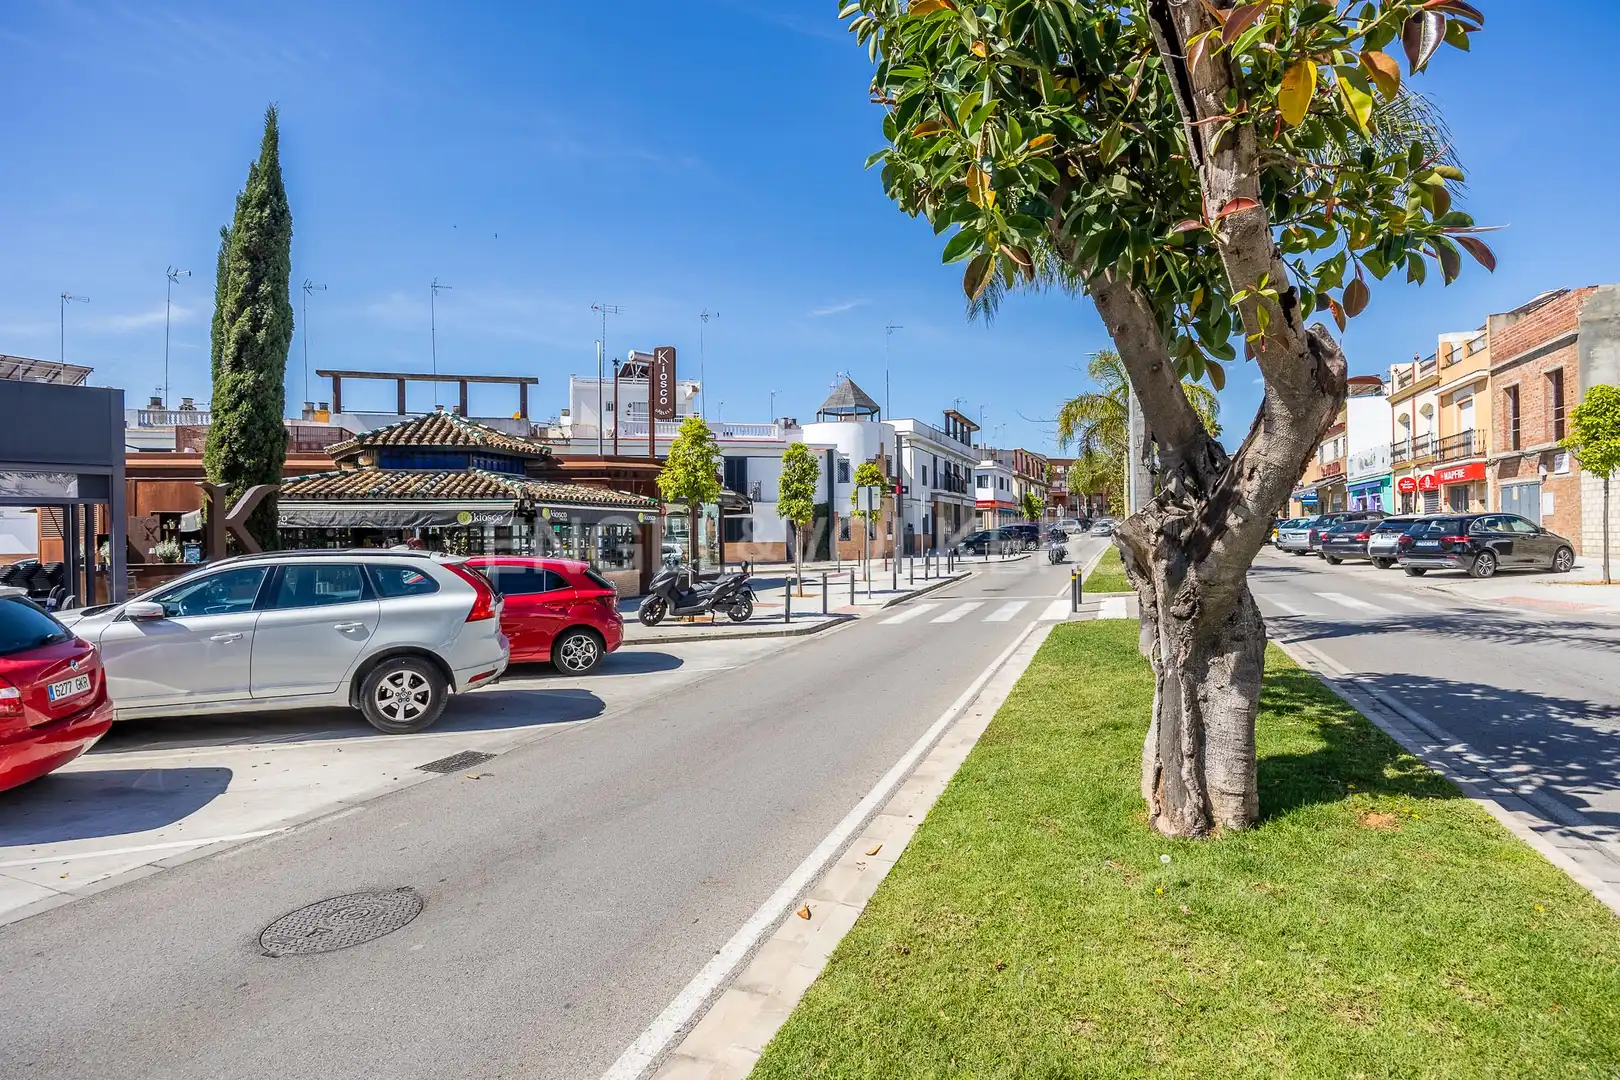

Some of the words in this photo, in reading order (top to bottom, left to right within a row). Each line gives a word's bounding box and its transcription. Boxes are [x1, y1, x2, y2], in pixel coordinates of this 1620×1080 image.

[658, 350, 669, 404] Kiosco
[1444, 469, 1465, 480] MAPFRE
[473, 512, 503, 522] kiosco
[551, 510, 567, 519] kiosco
[55, 681, 72, 697] 6277
[75, 677, 89, 690] GKR
